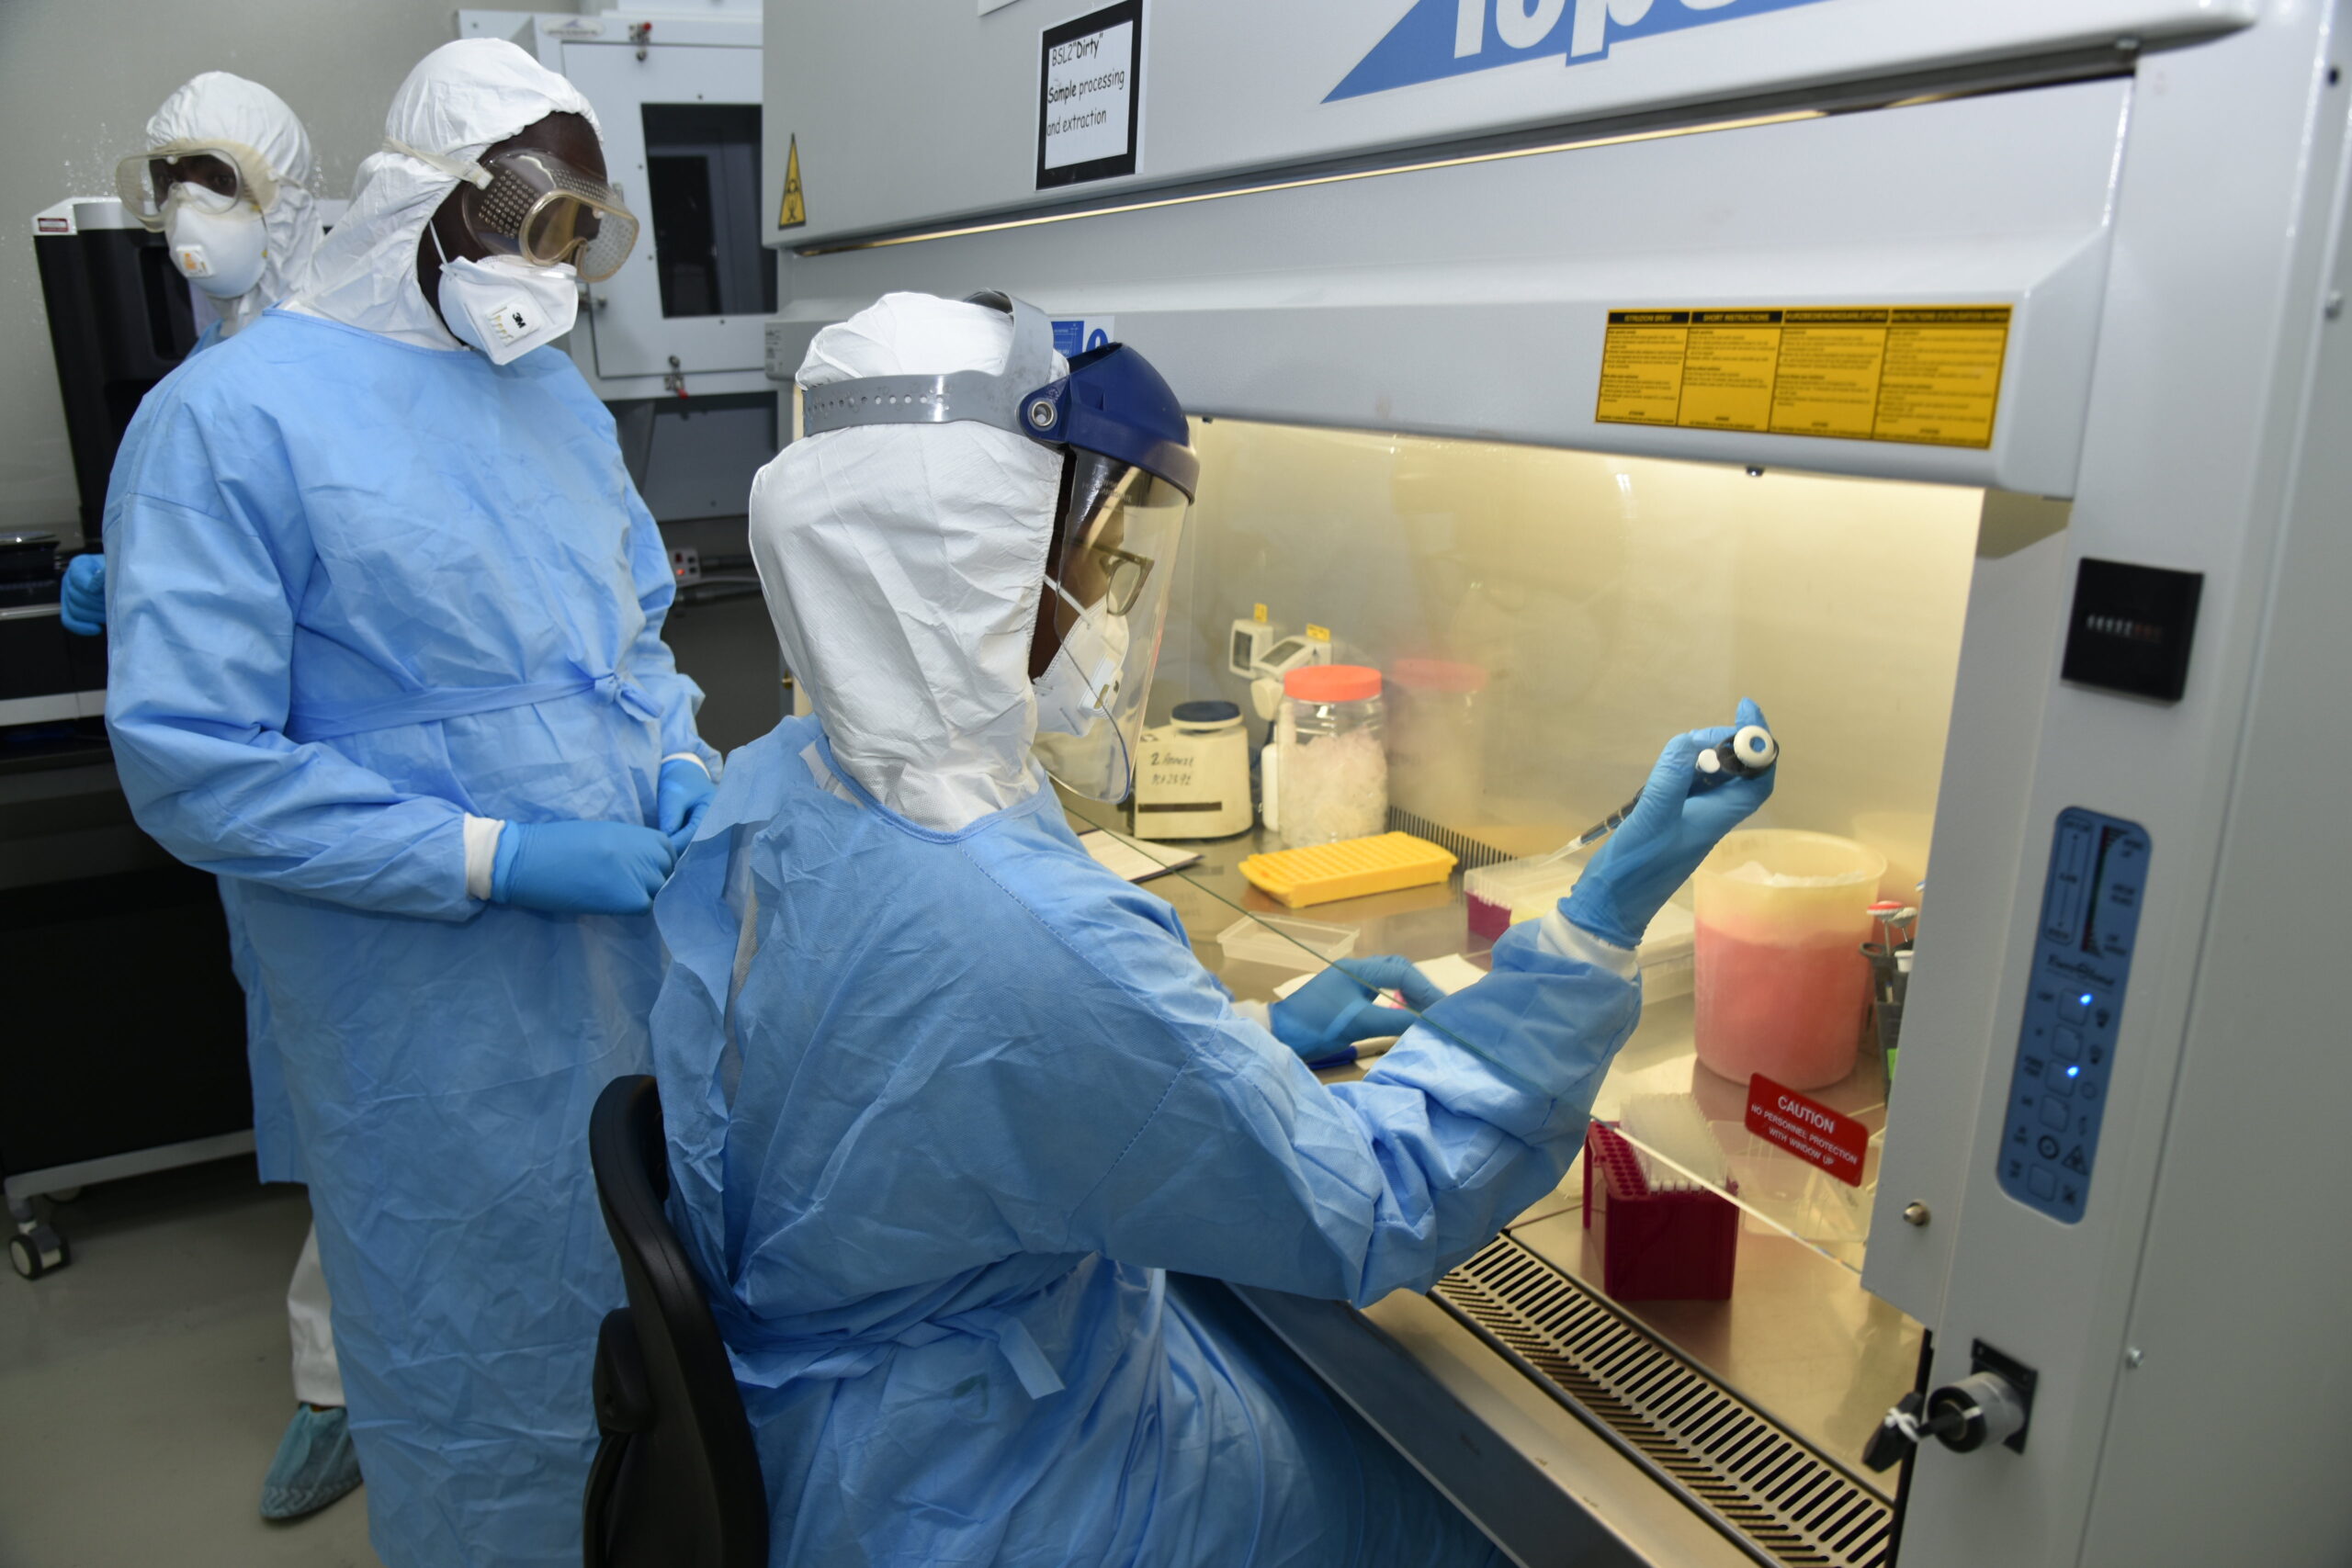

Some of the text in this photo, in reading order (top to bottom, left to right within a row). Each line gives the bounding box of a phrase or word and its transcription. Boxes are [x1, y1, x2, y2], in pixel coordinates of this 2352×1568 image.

[1047, 68, 1125, 105] Sample processing
[1046, 107, 1107, 137] and extraction
[512, 312, 526, 328] 3M
[1702, 312, 1770, 322] SHORT INSTRUCTIONS
[1778, 1095, 1836, 1134] CAUTION
[1751, 1104, 1859, 1166] NO PERSONNEL PROTECTION
[1769, 1126, 1836, 1167] WITH WINDOW UP
